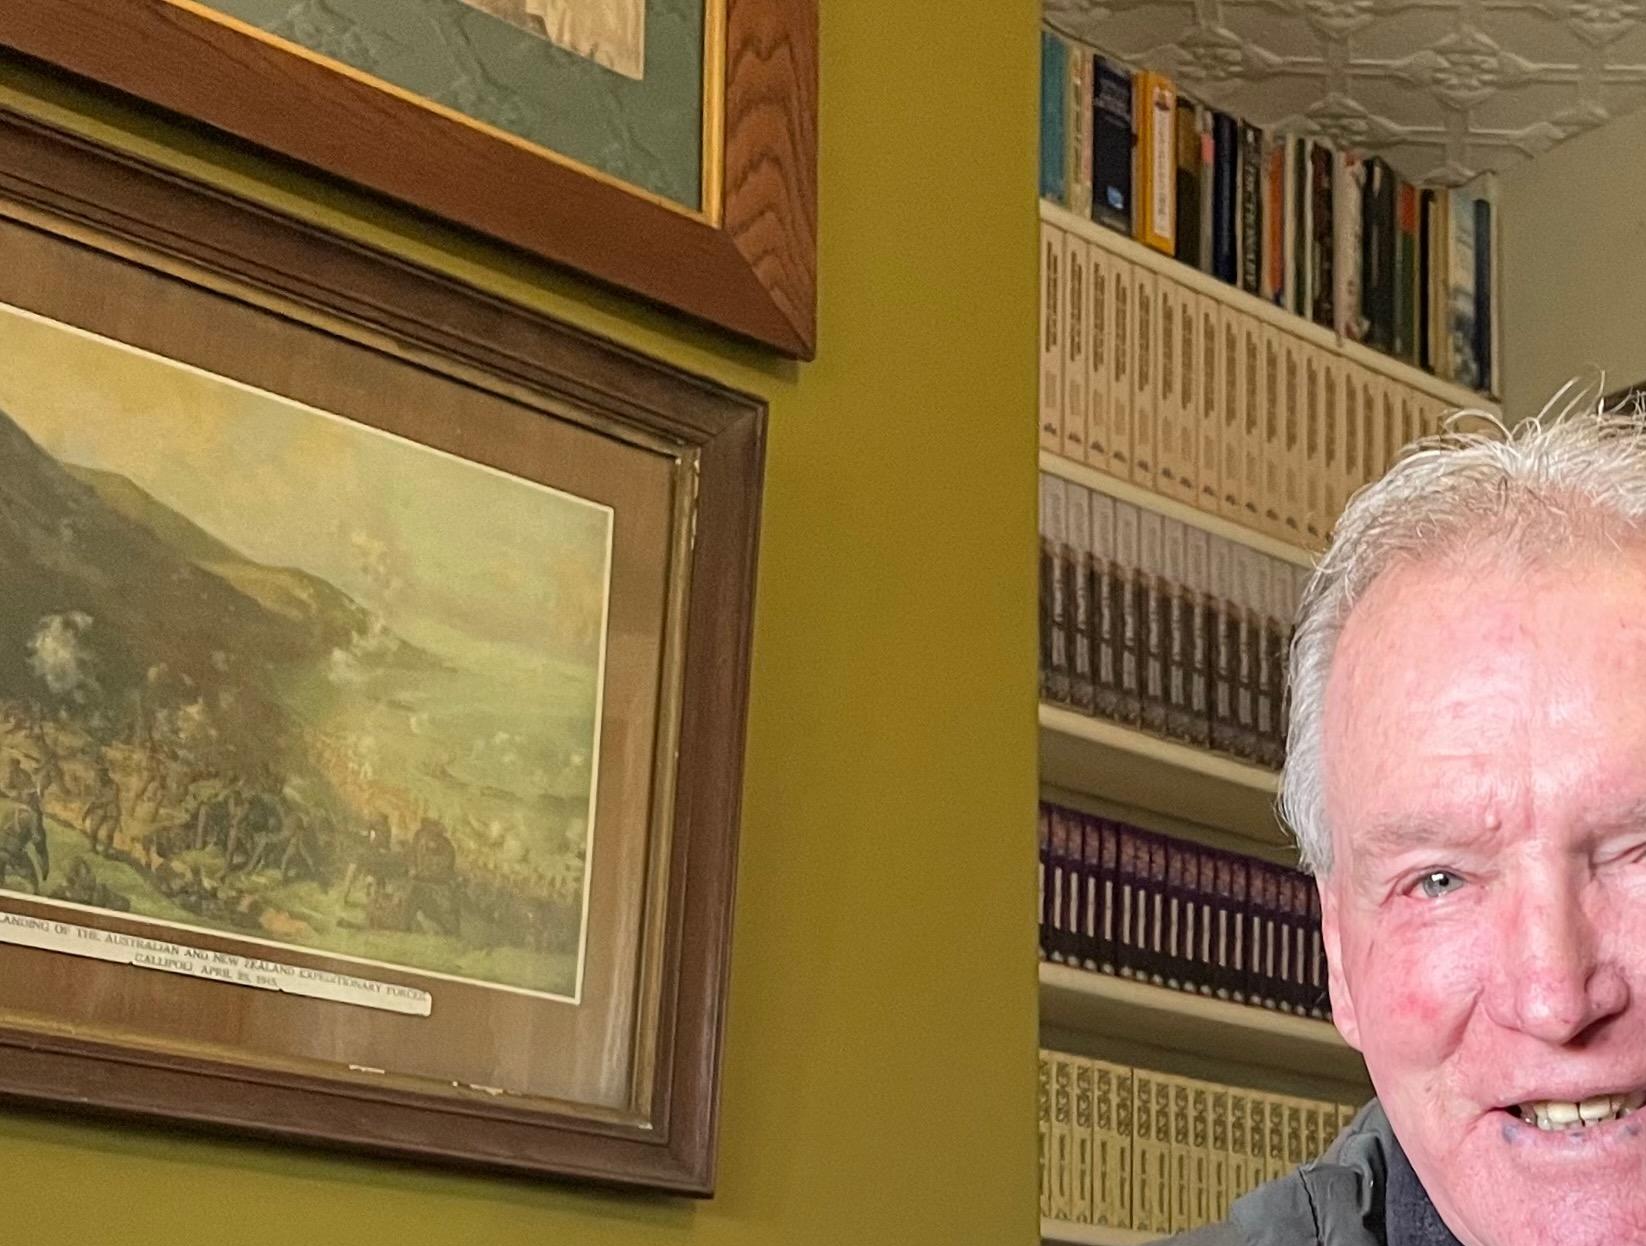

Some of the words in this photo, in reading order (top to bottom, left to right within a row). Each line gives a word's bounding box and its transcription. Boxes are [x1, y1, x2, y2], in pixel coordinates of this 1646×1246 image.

[54, 923, 69, 935] OF
[105, 933, 180, 955] AUSTRALIAN
[184, 948, 209, 961] AND
[213, 953, 240, 966] NEW
[244, 958, 296, 976] ZEALAND
[300, 969, 382, 994] EXPEDITIONARY
